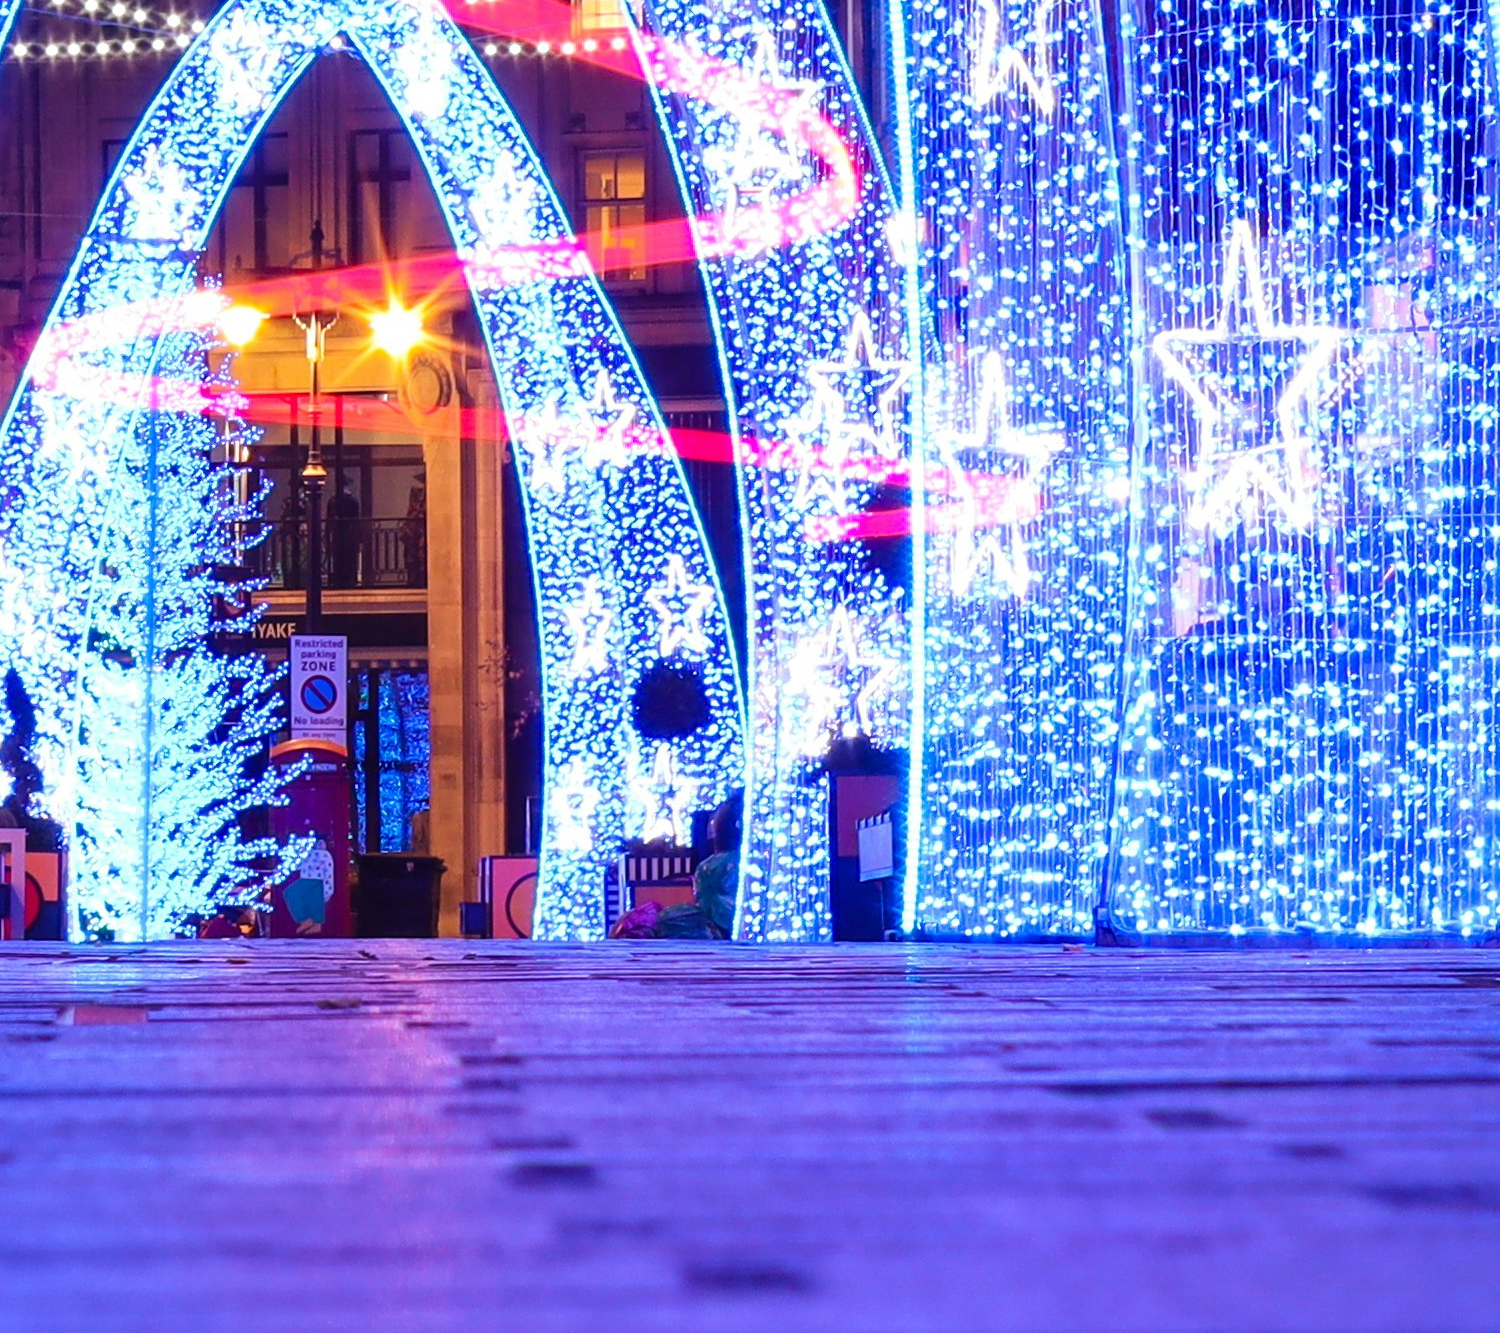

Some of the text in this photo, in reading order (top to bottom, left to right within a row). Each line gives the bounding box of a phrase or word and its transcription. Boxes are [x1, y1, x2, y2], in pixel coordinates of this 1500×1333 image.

[252, 622, 296, 639] IYAKE
[294, 639, 344, 648] Restricted
[301, 650, 336, 660] parking
[301, 661, 336, 672] ZONE
[294, 716, 344, 726] No loading
